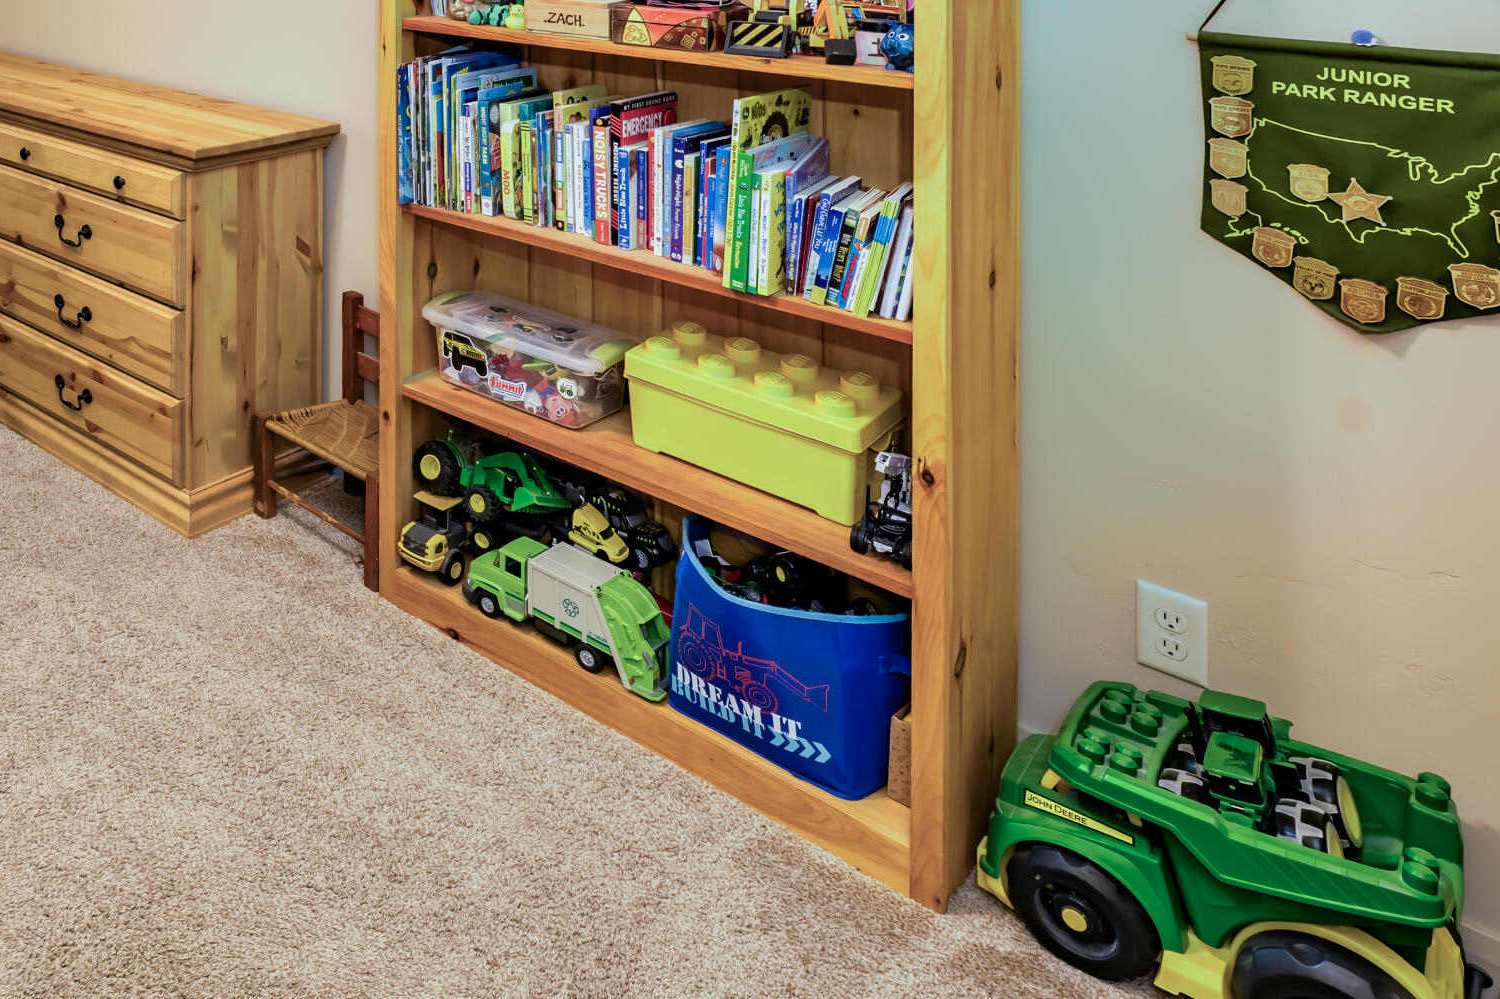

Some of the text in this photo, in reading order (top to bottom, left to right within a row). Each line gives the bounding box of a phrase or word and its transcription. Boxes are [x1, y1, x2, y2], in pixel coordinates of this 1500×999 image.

[1316, 67, 1411, 89] JUNIOR
[623, 103, 630, 111] MY
[1272, 81, 1455, 114] PARK RANGER
[622, 111, 663, 138] EMERGENCY
[502, 169, 510, 195] MOO
[594, 130, 608, 219] NOISY TRUCKS
[619, 167, 627, 230] Little Blue Truck
[820, 198, 829, 210] God
[818, 211, 828, 227] Gave
[814, 238, 823, 250] You
[841, 233, 852, 245] Who
[836, 246, 849, 263] Wears
[831, 265, 845, 283] What?
[671, 673, 736, 724] BUILD
[676, 661, 802, 741] DREAM IT
[1028, 793, 1088, 826] JOHN DEERE
